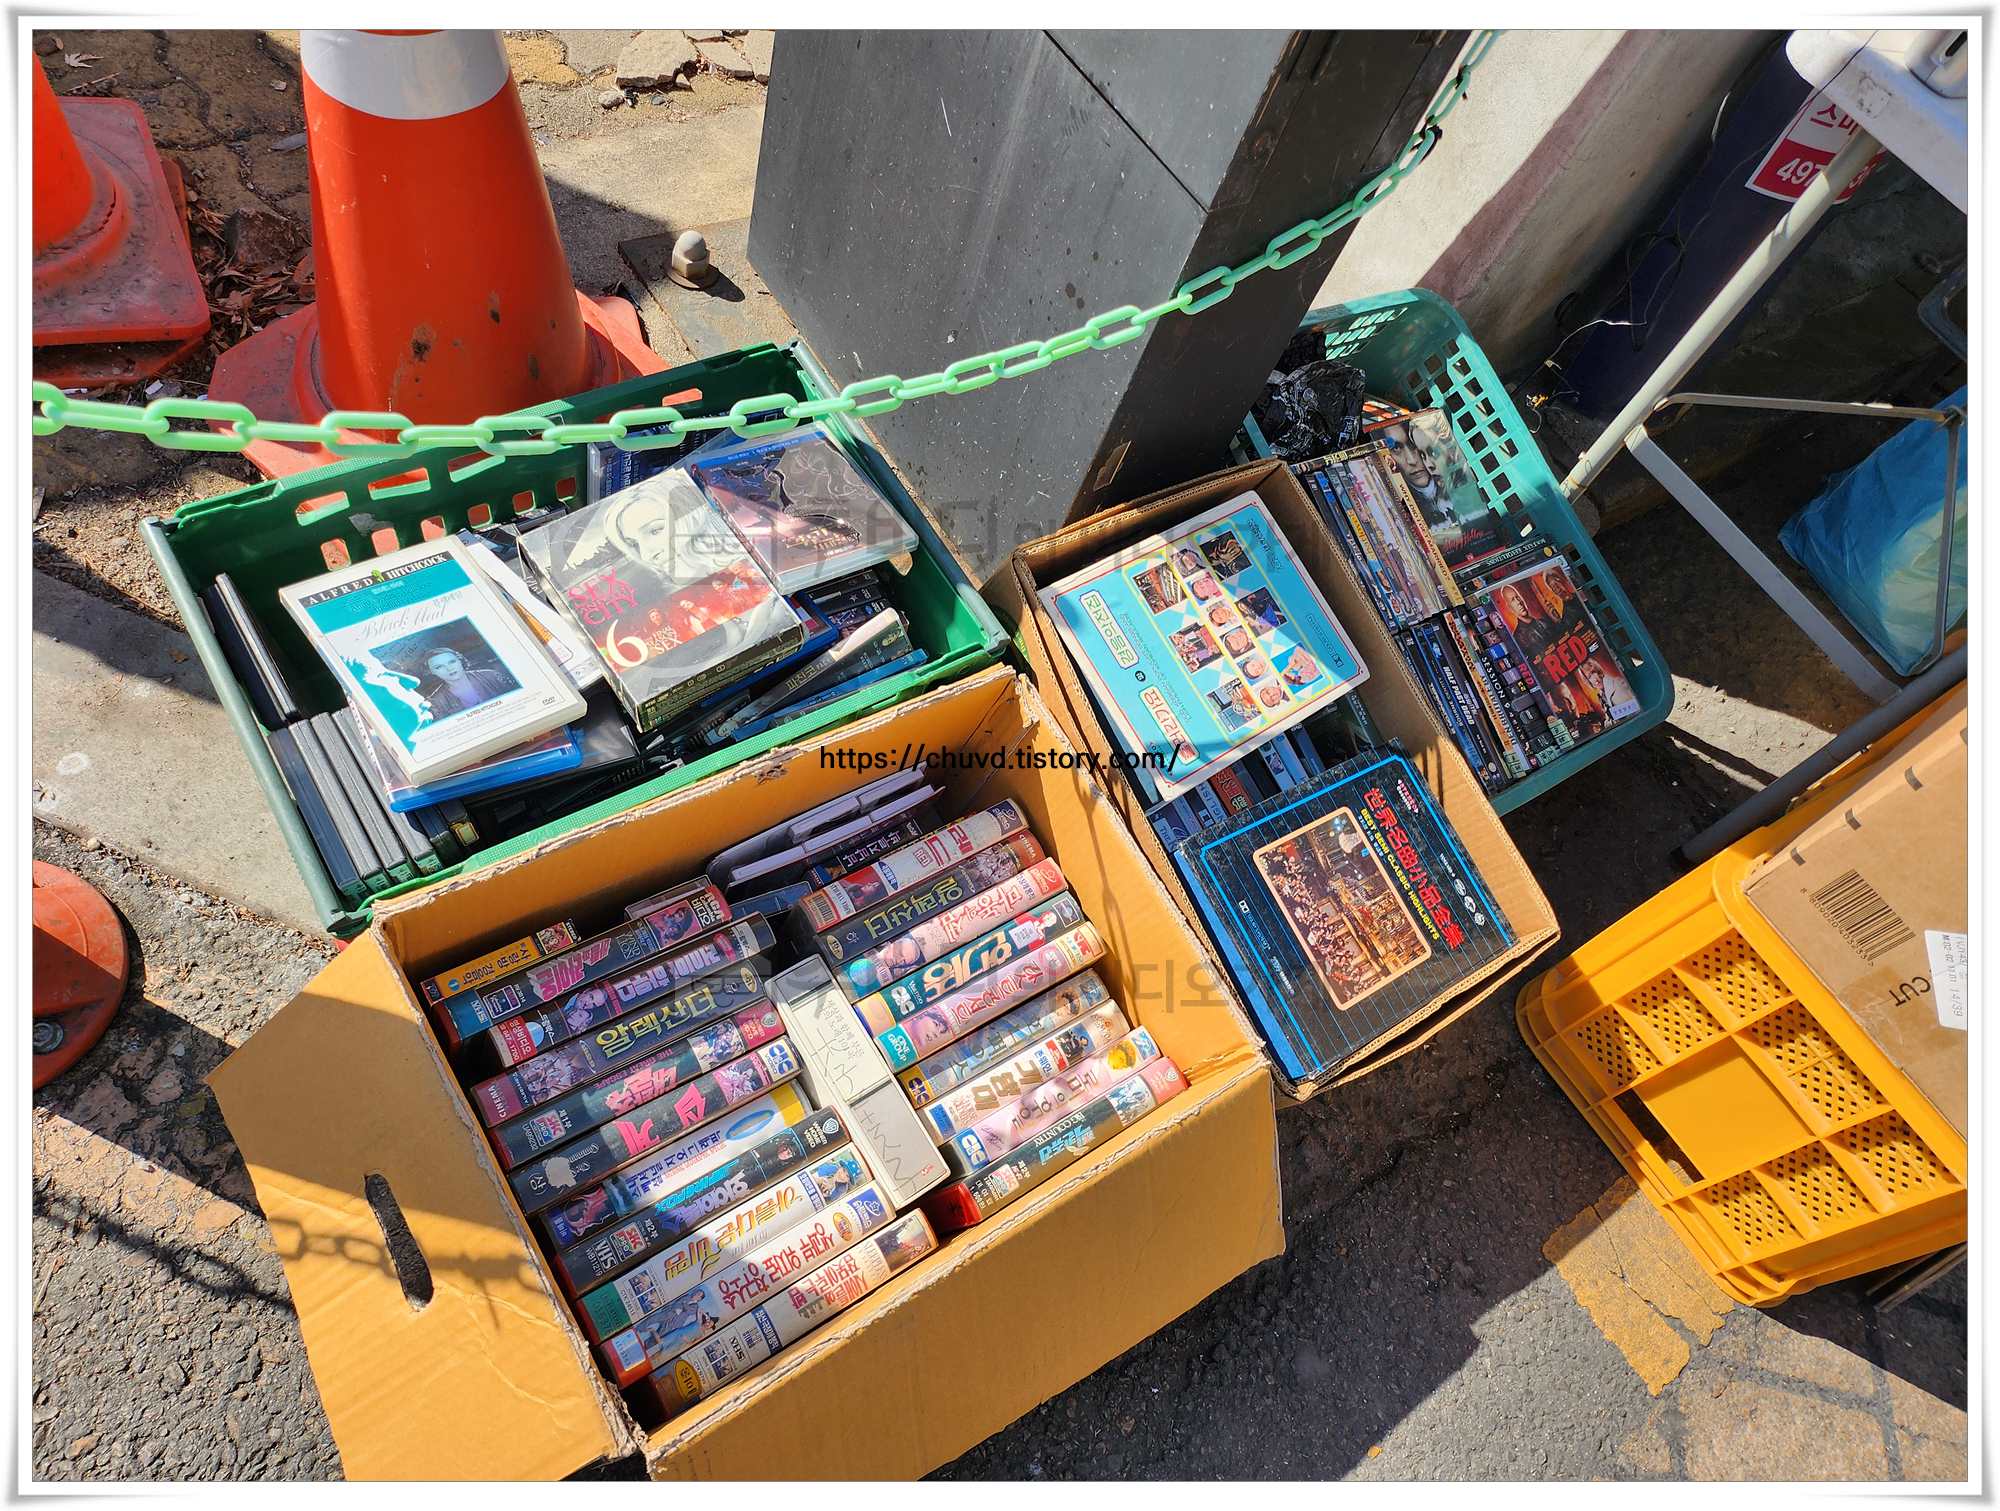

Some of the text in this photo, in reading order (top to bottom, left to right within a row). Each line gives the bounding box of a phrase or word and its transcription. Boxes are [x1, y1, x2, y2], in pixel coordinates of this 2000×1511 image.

[306, 573, 373, 606] ALFRED
[386, 552, 448, 581] HITCHCOCK
[569, 569, 619, 608] SEX
[582, 592, 640, 626] CITY
[606, 618, 649, 669] 6
[1542, 635, 1588, 683] RED
[1479, 655, 1507, 699] SESSION
[1518, 663, 1536, 687] RED
[1442, 665, 1475, 725] HALF PAST DEAD
[1197, 781, 1224, 823] NGLISH
[1397, 782, 1419, 811] STEREO
[923, 822, 974, 868] 레드
[1017, 831, 1037, 860] CINEMA
[1359, 807, 1378, 832] BEST
[1372, 831, 1391, 854] SEMI
[1384, 853, 1412, 891] CLASSIC
[1406, 891, 1441, 941] HIGHLIGHTS
[690, 897, 711, 928] 비디오
[862, 873, 966, 941] 알렉산더
[914, 929, 1016, 1003] 현기증
[1888, 975, 1932, 1007] CUT
[508, 1017, 533, 1055] 영상비디오
[593, 983, 717, 1060] 알렉산더
[885, 1031, 908, 1063] GROUP
[894, 1033, 910, 1053] ONE
[593, 1046, 673, 1092] THE GREAT ESCAPE
[486, 1085, 509, 1118] CINEMA
[905, 1075, 931, 1106] CIC
[802, 1128, 816, 1148] VIDEO
[807, 1125, 821, 1145] HOME
[811, 1120, 828, 1145] WARNER
[959, 1132, 989, 1169] CIC
[1030, 1118, 1073, 1147] COUNTRY
[641, 1217, 659, 1239] 제2부
[708, 1181, 808, 1251] 아름다운
[592, 1238, 619, 1271] VHS
[655, 1233, 717, 1282] 비행
[791, 1218, 839, 1263] 생과부
[760, 1243, 804, 1284] 위자료
[713, 1259, 772, 1312] 청구소송
[786, 1284, 808, 1310] 밤
[727, 1335, 746, 1361] VHS
